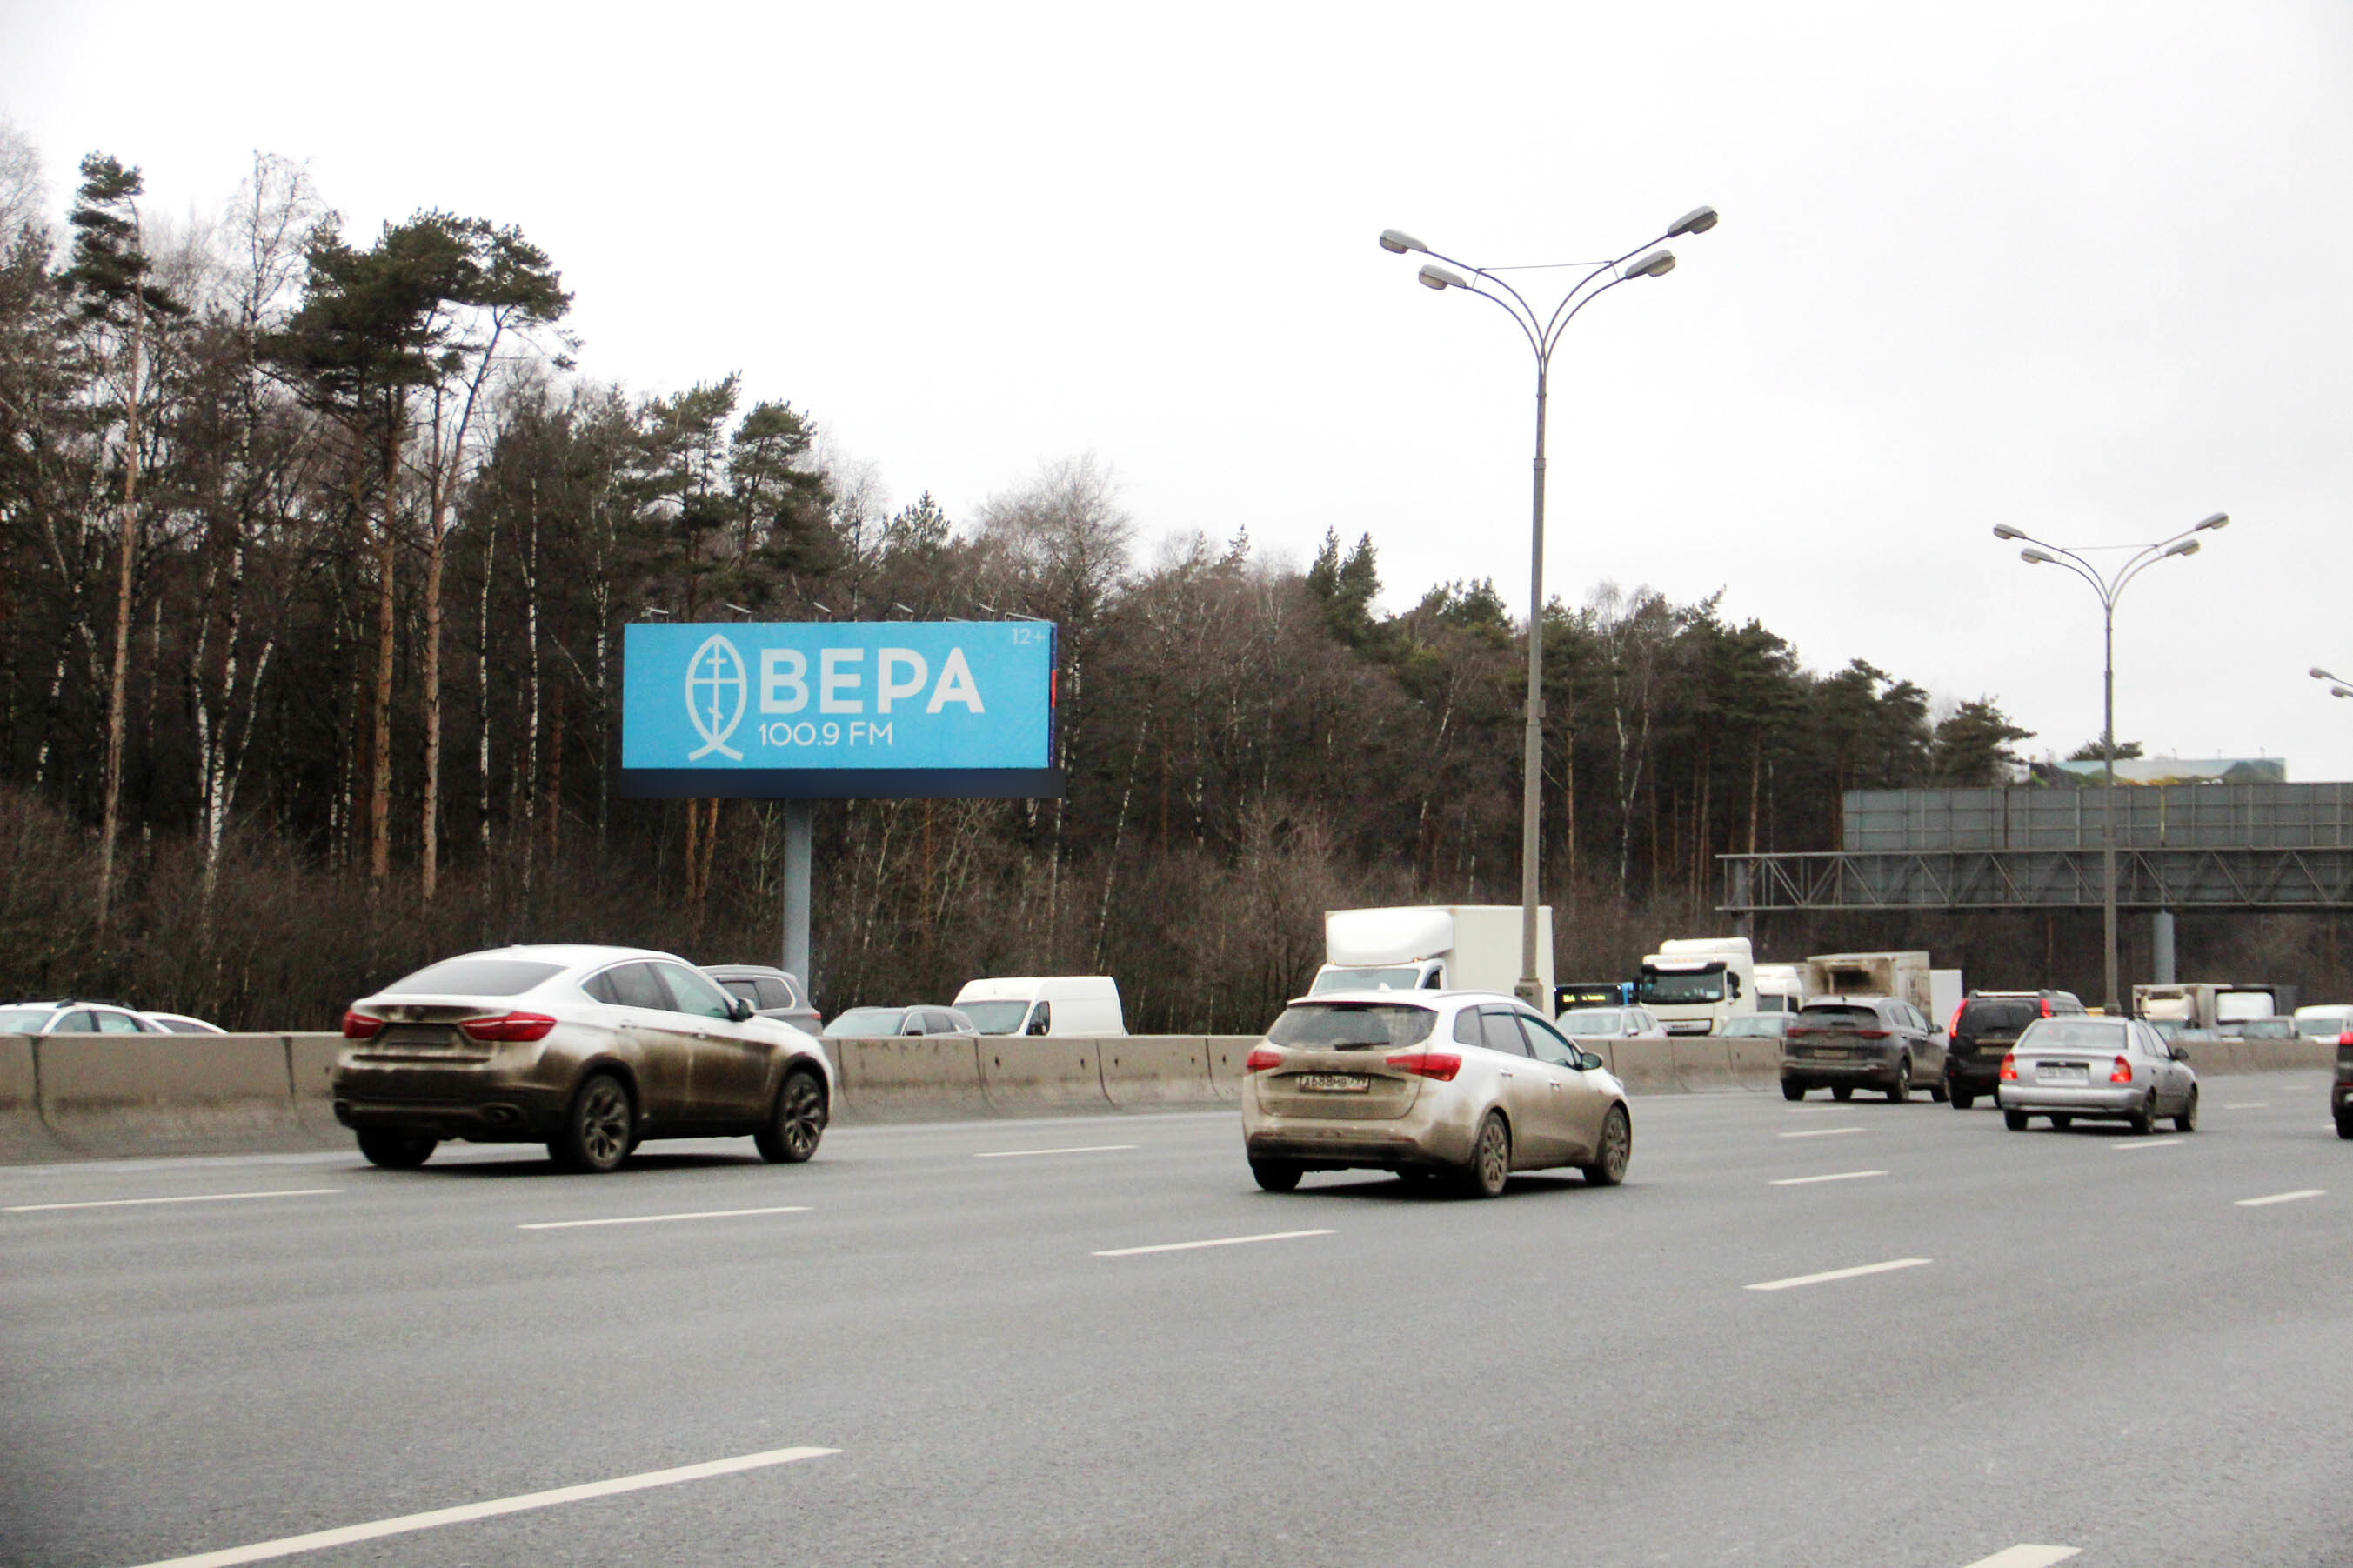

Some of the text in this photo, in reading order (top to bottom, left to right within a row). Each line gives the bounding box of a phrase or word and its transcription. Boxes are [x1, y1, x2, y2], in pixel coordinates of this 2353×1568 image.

[1011, 627, 1046, 645] 12+
[759, 646, 986, 715] ВЕРА
[759, 721, 893, 747] 100.9 FM
